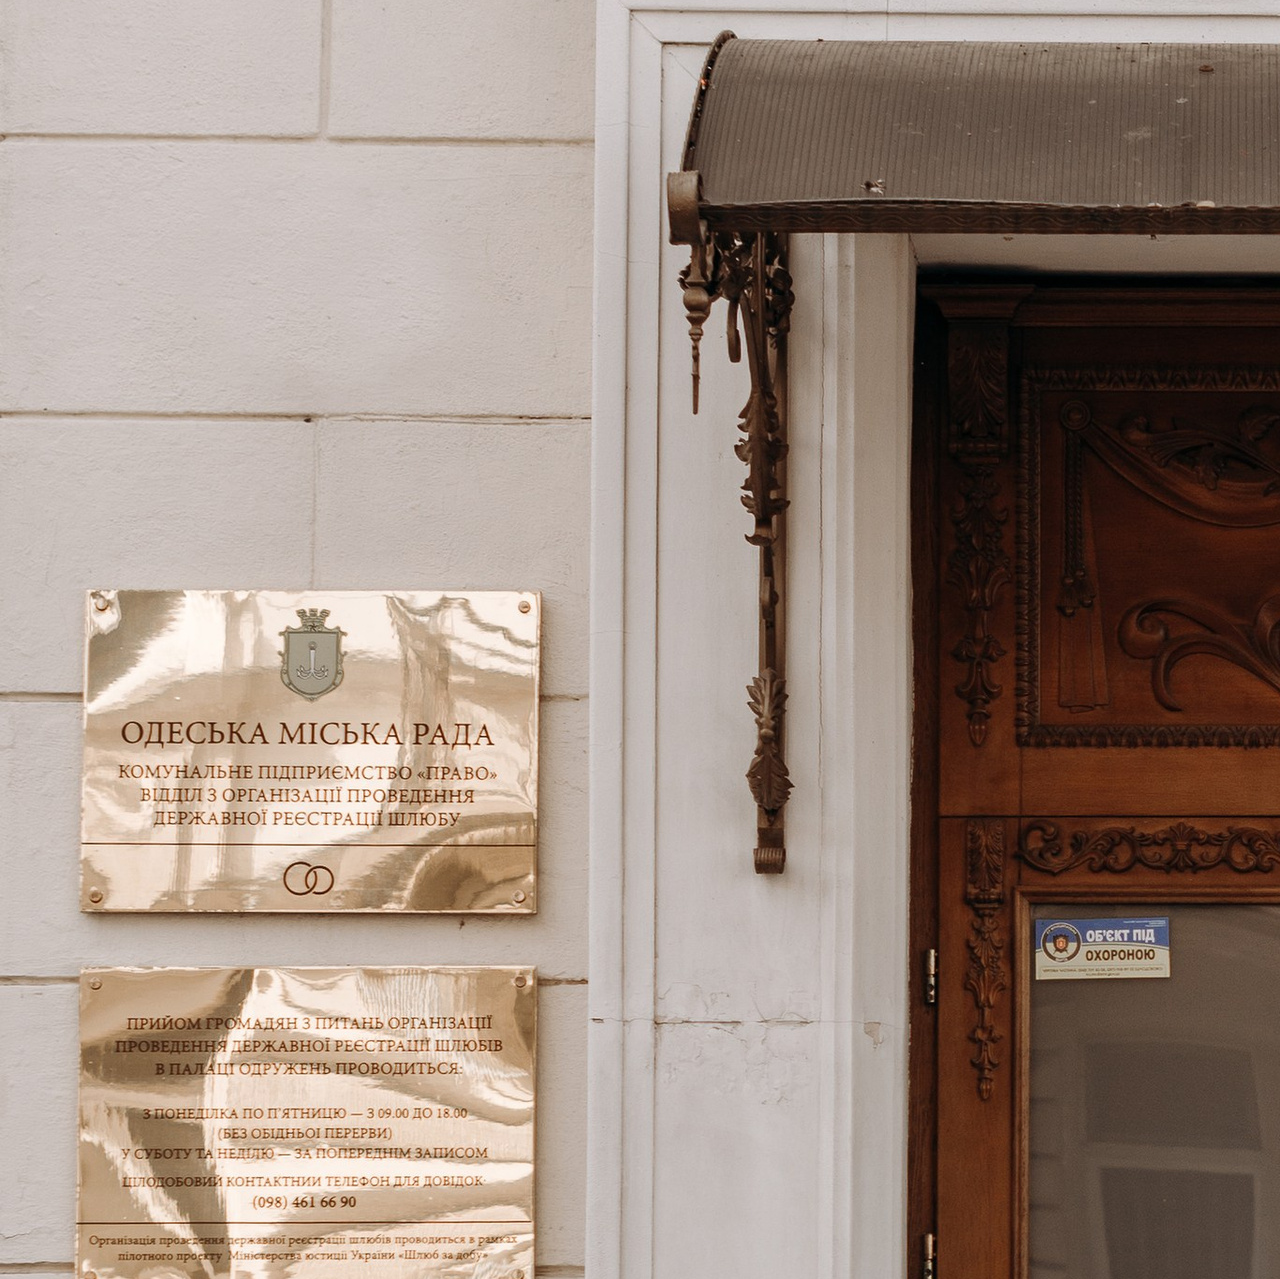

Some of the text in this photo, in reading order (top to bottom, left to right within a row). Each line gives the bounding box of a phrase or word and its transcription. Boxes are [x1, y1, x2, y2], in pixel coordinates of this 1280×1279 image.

[121, 721, 495, 750] ОДЕСЬКА МІСЬКА РАДА
[118, 764, 497, 782] КОМУНАЛЬНЕ ПІДПРИЄМСТВО «ПРАВО»
[140, 787, 202, 804] ВІДДІЛ
[222, 786, 341, 804] ОРГАНІЗАЦІЇ
[347, 789, 475, 805] ПРОВЕДЕННЯ
[153, 809, 461, 828] ДЕРЖАВНОЇ РЕЄСТРАЦІЇ ШЛЮБУ
[1133, 928, 1155, 943] ПІД
[1085, 949, 1156, 962] ОХОРОНОЮ
[127, 1015, 201, 1030] ПРИЙОМ
[206, 1017, 298, 1031] ГРОМАДЯН
[315, 1017, 384, 1030] ПИТАНЬ
[388, 1015, 493, 1031] ОРГАНІЗАЦІЇ
[115, 1038, 503, 1055] ПРОВЕДЕННЯ ДЕРЖАВНОЇ РЕЄСТРАЦІЇ ШЛЮБІВ
[155, 1062, 463, 1077] В ПАЛАЦІ ОДРУЖЕНЬ ПРОВОДИТЬСЯ:
[154, 1108, 238, 1121] ПОНЕДІЛКА
[242, 1108, 264, 1120] ПО
[378, 1108, 409, 1119] 09.00
[412, 1108, 433, 1120] ДО
[437, 1108, 468, 1119] 18.00
[218, 1128, 247, 1141] (БЕЗ
[324, 1128, 393, 1140] ПЕРЕРВИ)
[121, 1148, 131, 1160] У
[133, 1148, 192, 1160] СУБОТУ
[195, 1148, 213, 1160] ТА
[218, 1148, 274, 1161] НЕДІЛЮ
[295, 1148, 312, 1159] ЗА
[316, 1148, 411, 1160] ПОПЕРЕДНІМ
[415, 1147, 488, 1159] ЗАПИСОМ
[122, 1174, 223, 1188] ЦІЛОДОБОВИЙ
[325, 1176, 390, 1187] ТЕЛЕФОН
[393, 1176, 420, 1188] ДЛЯ
[252, 1195, 357, 1210] (098) 461 66 90
[89, 1235, 156, 1248] Організація
[158, 1237, 225, 1248] проведення
[227, 1235, 286, 1248] державної
[348, 1234, 392, 1244] шлюбів
[394, 1236, 466, 1247] проводиться
[477, 1236, 518, 1247] рамках
[118, 1251, 173, 1262] пілотного
[228, 1251, 302, 1263] Міністерства
[304, 1251, 348, 1261] юстиції
[350, 1250, 395, 1262] України
